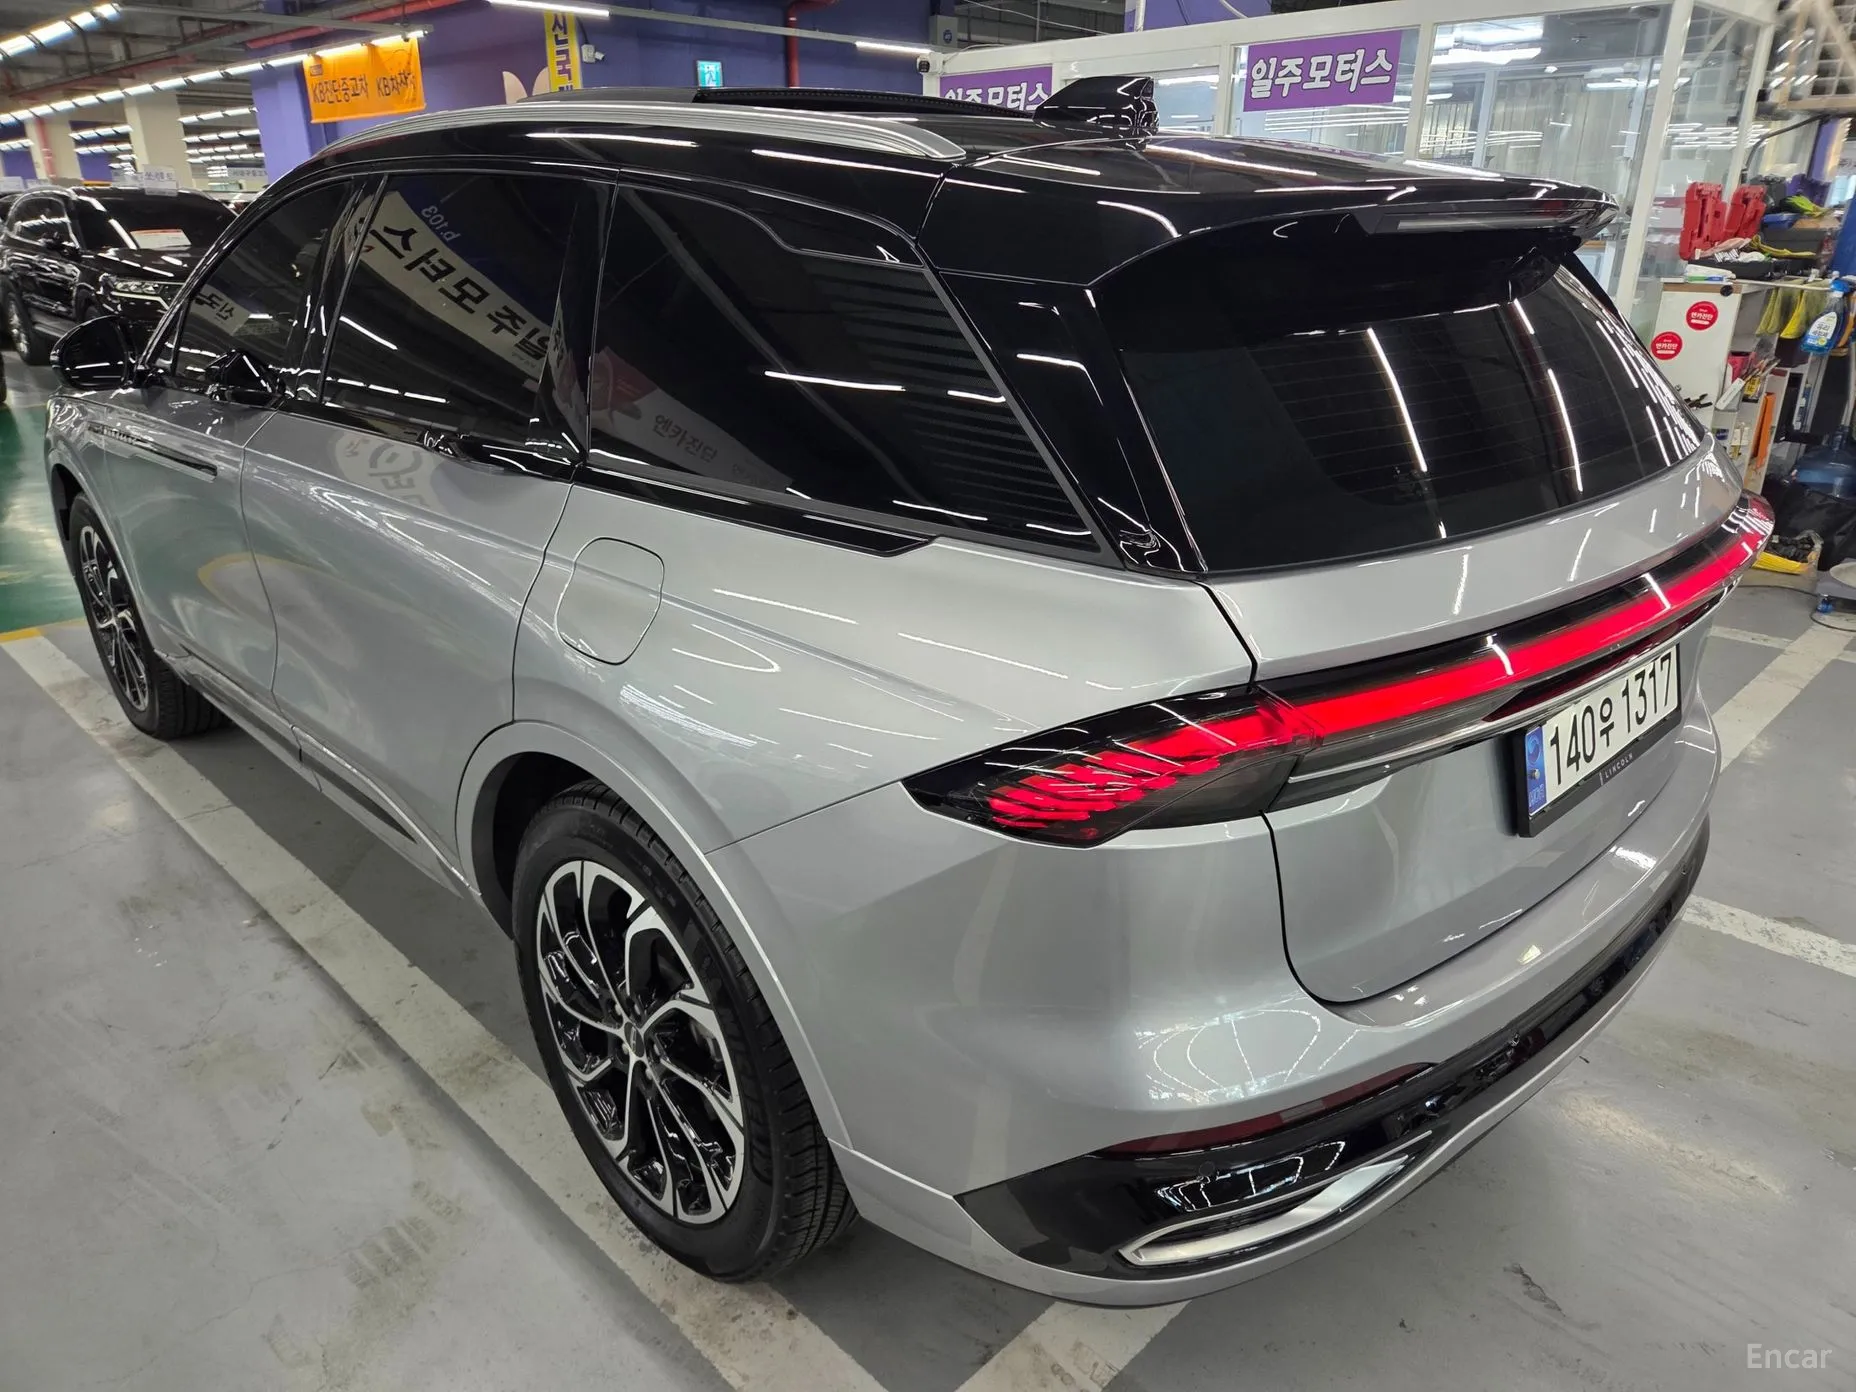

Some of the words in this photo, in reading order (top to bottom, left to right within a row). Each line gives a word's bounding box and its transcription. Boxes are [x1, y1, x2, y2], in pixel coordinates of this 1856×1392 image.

[1250, 48, 1394, 99] 일주모터스
[1550, 697, 1615, 785] 140우
[1622, 652, 1672, 734] 1317
